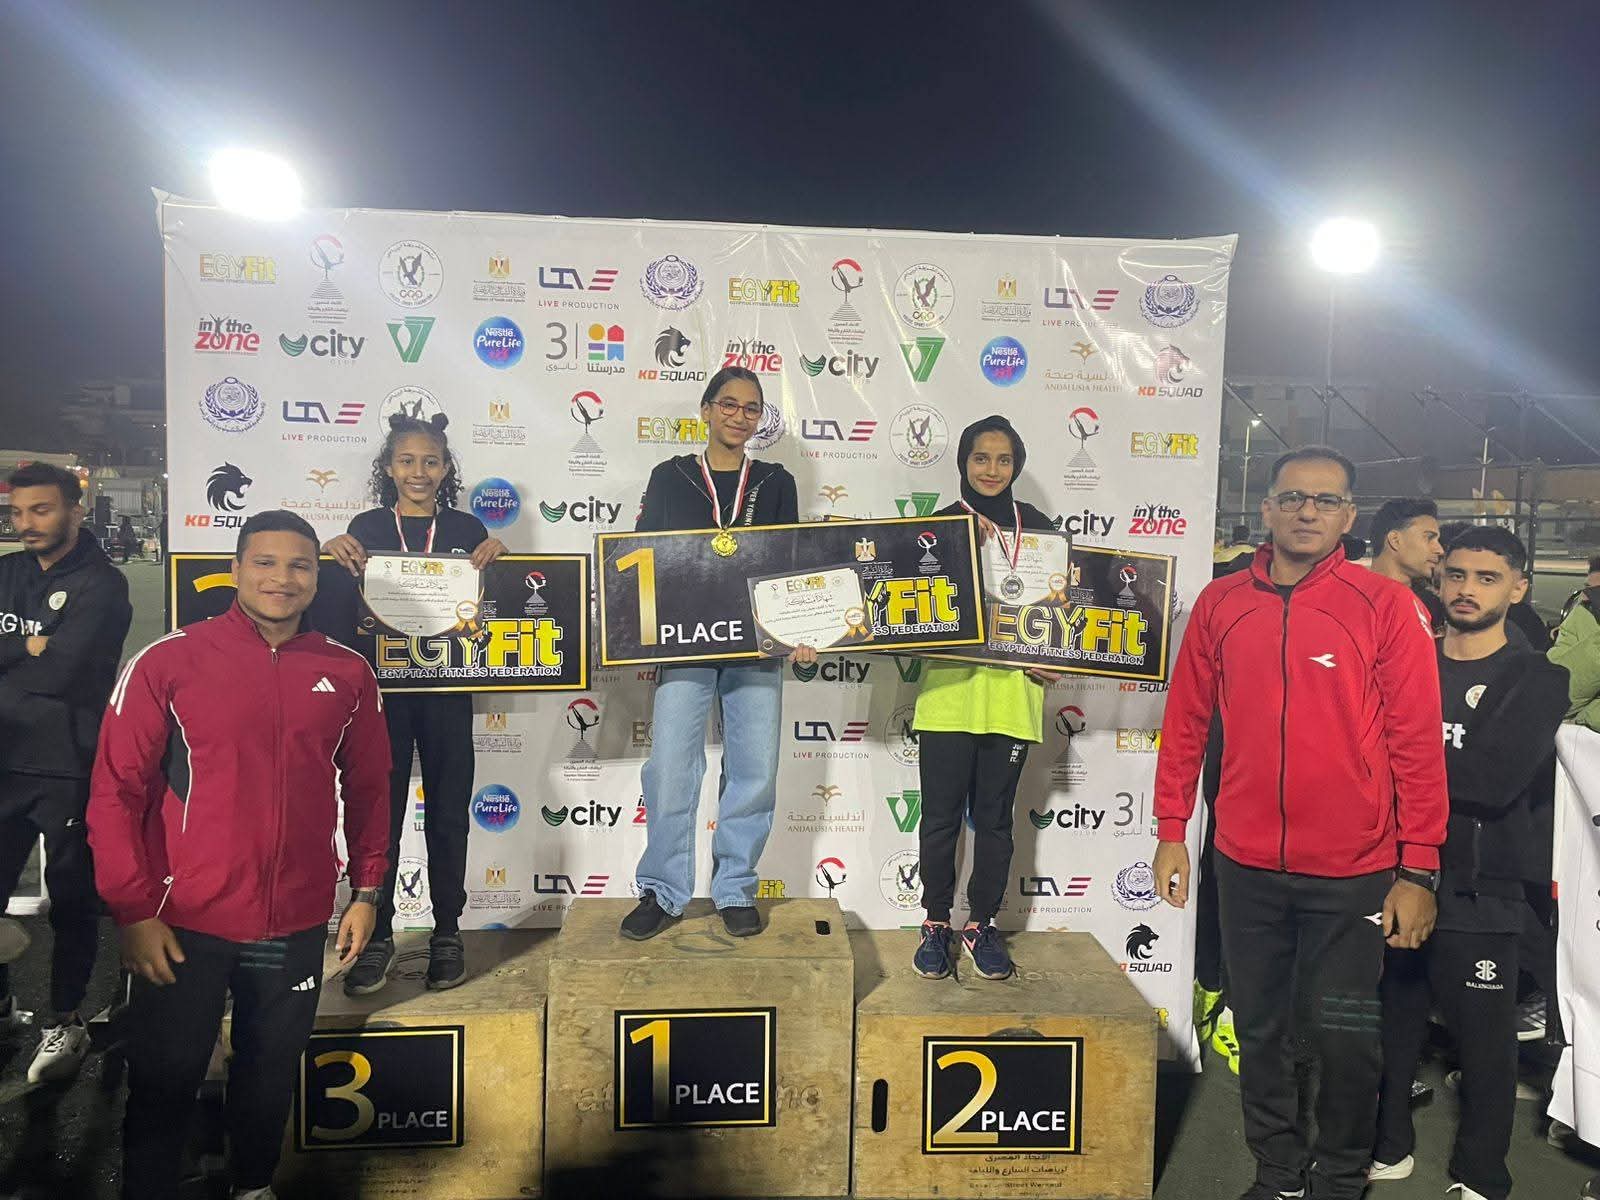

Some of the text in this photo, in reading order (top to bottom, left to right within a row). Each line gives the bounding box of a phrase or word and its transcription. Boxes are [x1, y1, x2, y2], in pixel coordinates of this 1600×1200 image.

[728, 278, 800, 304] EGYFit
[538, 300, 620, 310] LIVE PRODUCTION
[226, 316, 253, 333] the
[1042, 319, 1062, 327] LIVE
[194, 331, 261, 352] zone
[310, 328, 366, 359] city
[752, 340, 775, 355] the
[721, 353, 783, 373] zone
[828, 349, 880, 379] city
[1158, 386, 1203, 398] SQUAD
[281, 433, 368, 443] LIVE PRODUCTION
[637, 416, 708, 441] EGYFit
[1130, 431, 1199, 456] EGYFit
[801, 451, 878, 460] LIVE PRODUCTION
[569, 495, 622, 523] city
[1133, 504, 1181, 519] in the
[213, 514, 250, 529] SQU
[1065, 508, 1116, 537] city
[1128, 517, 1188, 536] zone
[865, 575, 960, 627] YFit
[660, 620, 744, 645] PLACE
[890, 621, 960, 635] FEDERATION
[988, 602, 1149, 657] EGYFit
[989, 642, 1145, 666] EGYPTIAN FITNESS FEDERATION
[377, 666, 562, 678] EGYPTIAN FITNESS FEDERATION
[820, 656, 871, 683] city
[1138, 682, 1170, 693] SQU
[1116, 727, 1162, 750] EGY
[793, 751, 869, 760] LIVE PRODUCTION
[570, 799, 622, 827] city
[787, 810, 817, 822] صحة
[1056, 803, 1106, 830] city
[787, 825, 865, 833] ANDALUSIA HEALTH
[757, 879, 786, 899] Fit
[532, 904, 553, 912] LIVE
[1039, 906, 1093, 914] PRODUCTION
[1129, 962, 1173, 973] SQUAD
[310, 1050, 448, 1141] 3 PLACE
[675, 1082, 760, 1105] PLACE
[932, 1050, 1066, 1144] 2 PLACE
